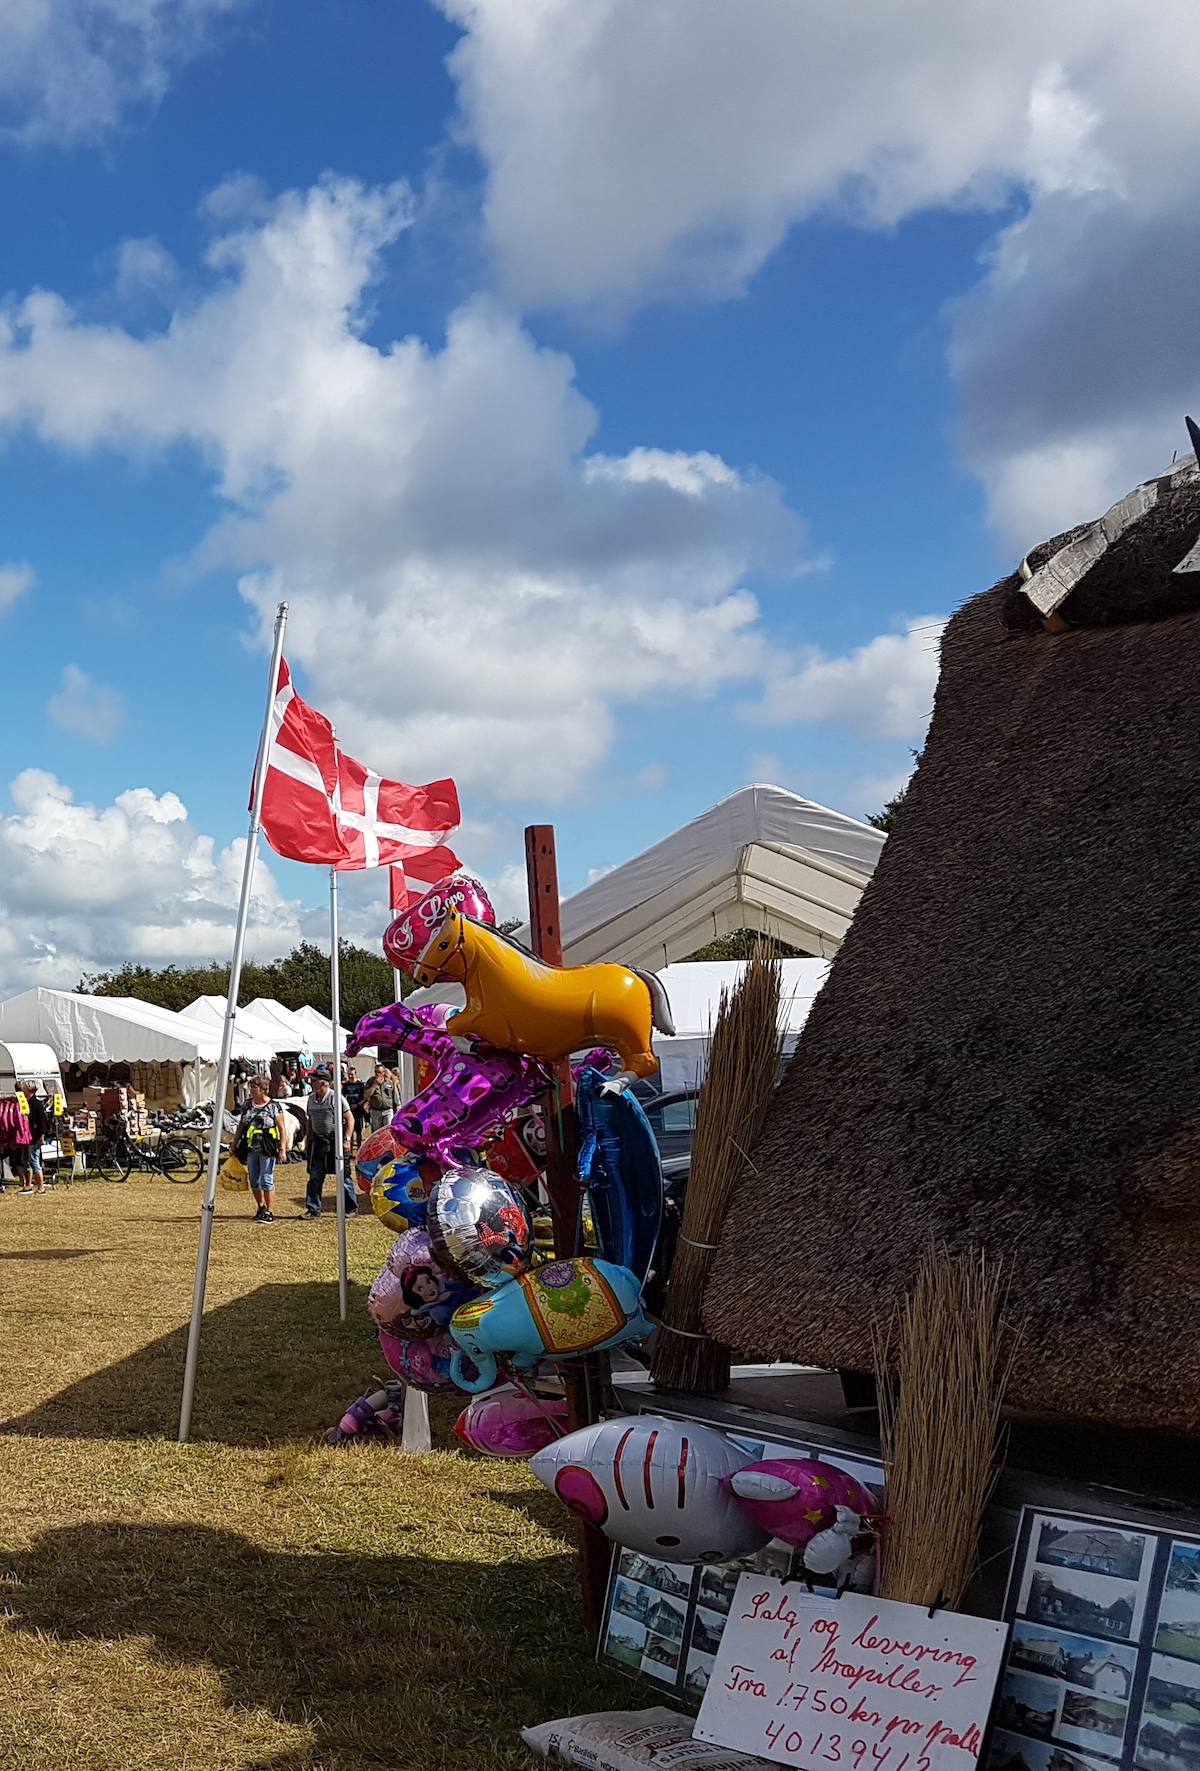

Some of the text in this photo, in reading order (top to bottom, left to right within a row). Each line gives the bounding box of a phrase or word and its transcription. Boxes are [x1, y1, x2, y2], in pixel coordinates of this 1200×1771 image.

[418, 891, 465, 928] Love
[742, 1591, 800, 1640] Salg
[809, 1618, 841, 1653] og
[851, 1614, 978, 1688] levering
[769, 1637, 801, 1674] af
[724, 1665, 768, 1698] Fra
